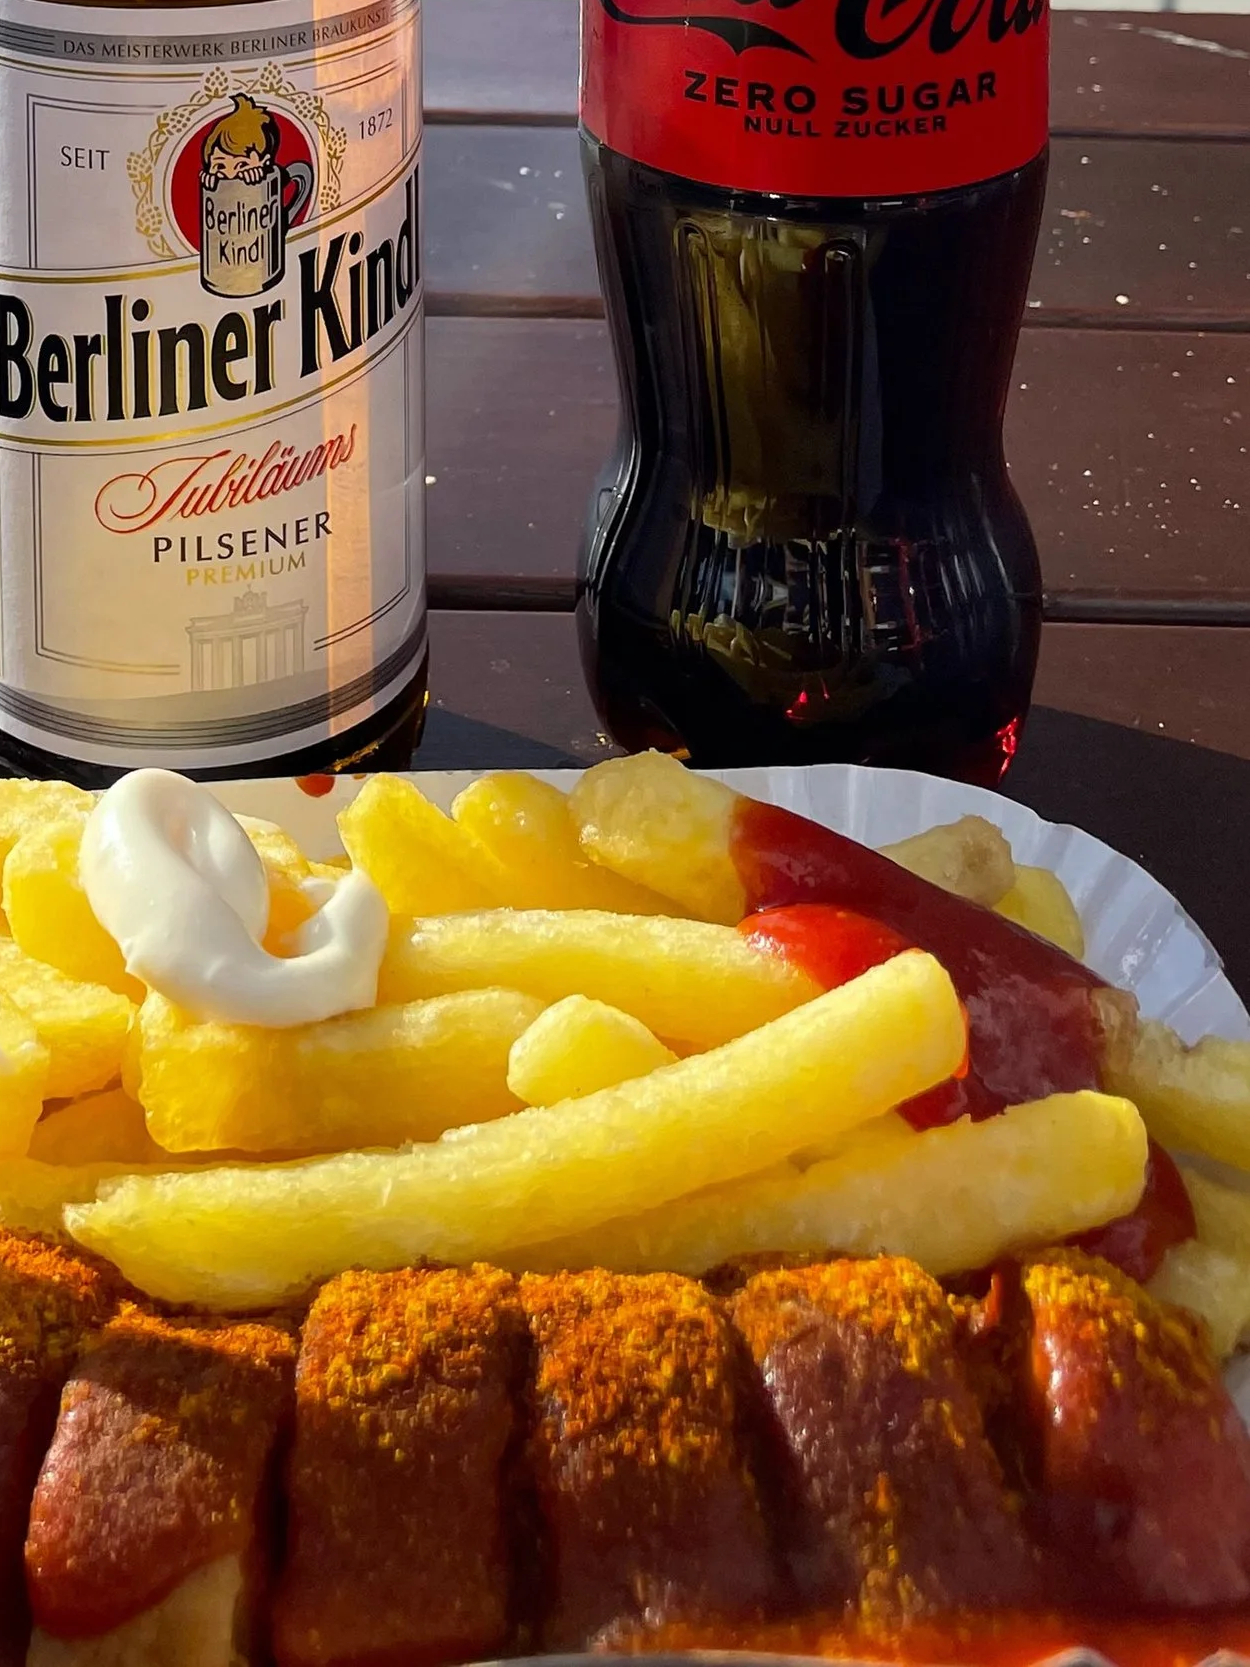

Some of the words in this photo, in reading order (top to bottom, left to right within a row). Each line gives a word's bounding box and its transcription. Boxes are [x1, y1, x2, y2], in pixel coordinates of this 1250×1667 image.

[63, 39, 96, 56] DAS
[101, 42, 225, 58] MEISTERWERK
[230, 31, 307, 55] BERLINER
[312, 7, 387, 43] BRAUKUNST
[684, 70, 817, 115] ZERO
[842, 71, 997, 116] SUGAR
[60, 145, 110, 171] SEIT
[358, 107, 394, 140] 1872
[744, 114, 821, 138] NULL
[833, 115, 948, 139] ZUCKER
[205, 197, 278, 235] Berliner
[219, 234, 264, 266] Kindl
[298, 161, 420, 377] Kindl
[94, 423, 358, 534] Jubiläums
[152, 510, 333, 564] PILSENER
[185, 551, 306, 586] PREMIUM
